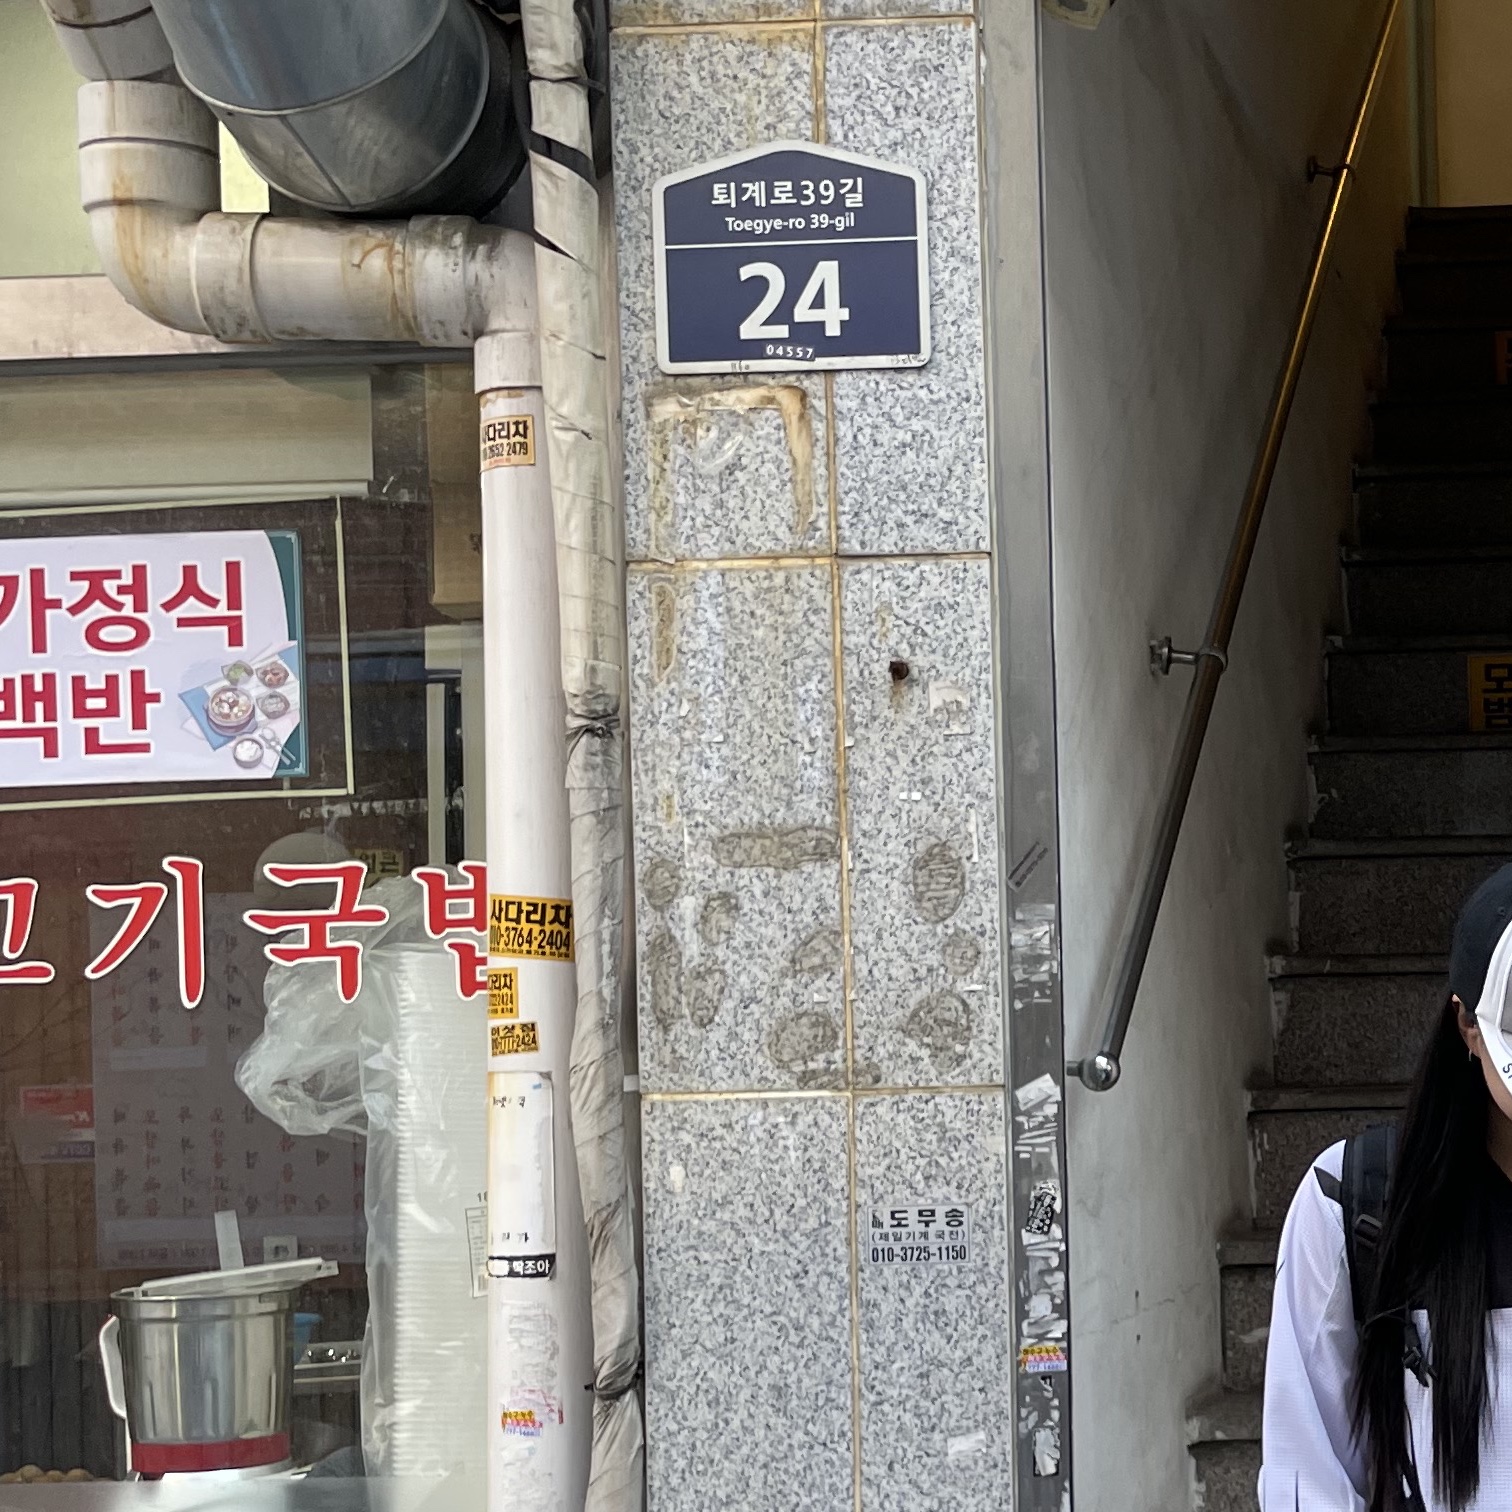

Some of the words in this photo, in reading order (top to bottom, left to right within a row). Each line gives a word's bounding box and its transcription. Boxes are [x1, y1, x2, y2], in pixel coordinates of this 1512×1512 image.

[711, 177, 864, 208] 퇴계로39길
[724, 215, 806, 234] Toegye-ro
[810, 212, 855, 231] 39-gil
[738, 260, 850, 340] 24
[766, 344, 814, 359] 04557
[0, 560, 247, 654] 가정식
[0, 668, 162, 760] 백반
[491, 899, 573, 929] 사다리차
[890, 1208, 964, 1228] 도무송
[872, 1245, 966, 1263] 010-3725-1150
